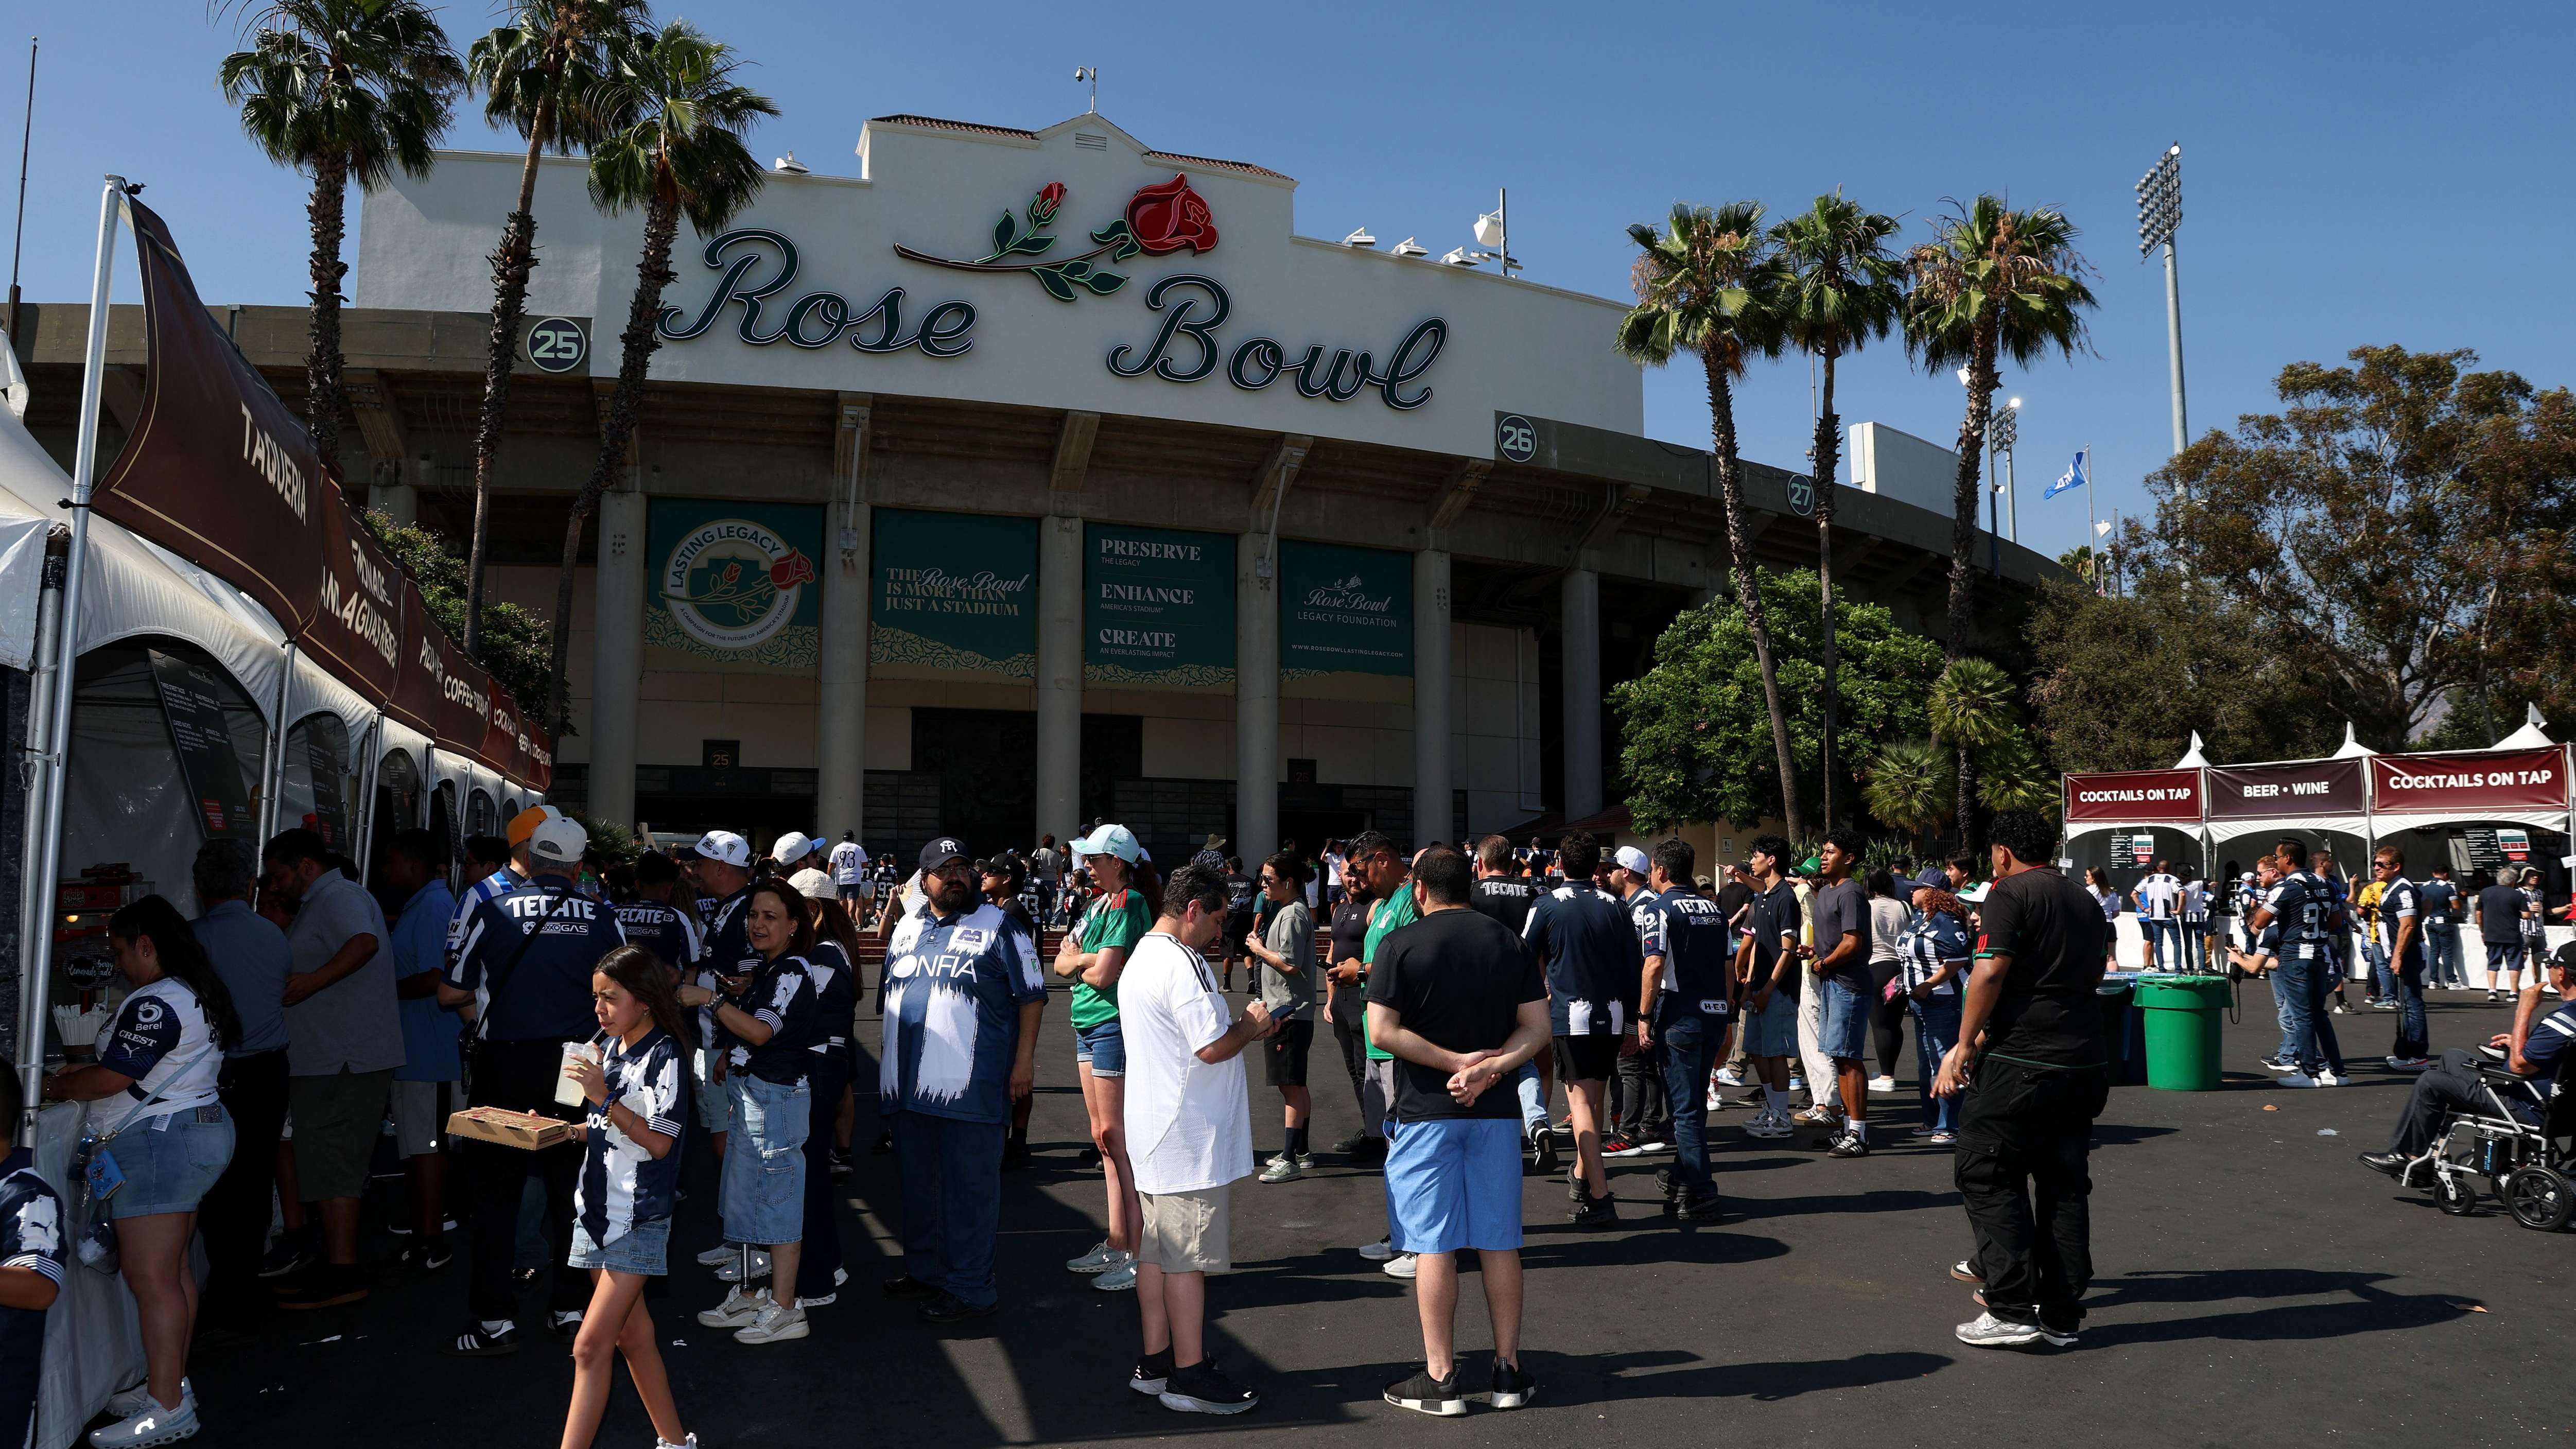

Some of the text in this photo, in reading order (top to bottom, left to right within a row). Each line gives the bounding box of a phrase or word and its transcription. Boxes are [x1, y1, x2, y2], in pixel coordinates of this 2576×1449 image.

[655, 228, 1450, 407] Rose Bowl
[533, 330, 579, 359] 25
[1503, 425, 1533, 452] 26
[241, 400, 306, 527] TAQUERIA
[1791, 482, 1811, 507] 27
[671, 526, 781, 588] LASTING LEGACY
[1101, 538, 1202, 561] PRESERVE
[1101, 556, 1141, 567] THE LEGACY
[351, 538, 393, 608] EMONADE
[886, 567, 1030, 592] THE Rose Bowl
[886, 582, 1006, 601] IS MORE THAN
[1101, 583, 1194, 605] ENHANCE
[1303, 589, 1392, 613] Rose Bowl
[885, 596, 1019, 617] JUST A STADIUM
[1100, 603, 1132, 612] AMERICA'S
[341, 590, 381, 648] AGUAS
[683, 612, 706, 634] CAMPAIGN
[705, 630, 716, 639] FOR
[756, 616, 779, 636] AMERICA'S
[778, 595, 790, 617] STADIUM
[1298, 611, 1397, 628] LEGACY FOUNDATION
[1100, 629, 1175, 648] CREATE
[1110, 649, 1151, 657] EVERLASTING
[1292, 644, 1404, 658] WWW.ROSEBOWLLASTINGLEGACY.COM
[444, 675, 473, 709] COFFEE
[712, 754, 729, 766] 25
[2243, 781, 2329, 798] BEER WINE
[2389, 770, 2552, 790] COCKTAILS ON TAP
[2079, 787, 2191, 803] COCKTAILS ON TAP
[839, 850, 856, 869] 93
[65, 888, 85, 899] Hola
[1481, 881, 1529, 898] TECATE
[504, 895, 597, 921] TECATE
[1672, 898, 1722, 915] TECATE
[561, 923, 587, 933] GAS
[67, 964, 97, 977] Lemonade
[135, 1021, 163, 1032] Berel
[118, 1029, 158, 1048] CREST
